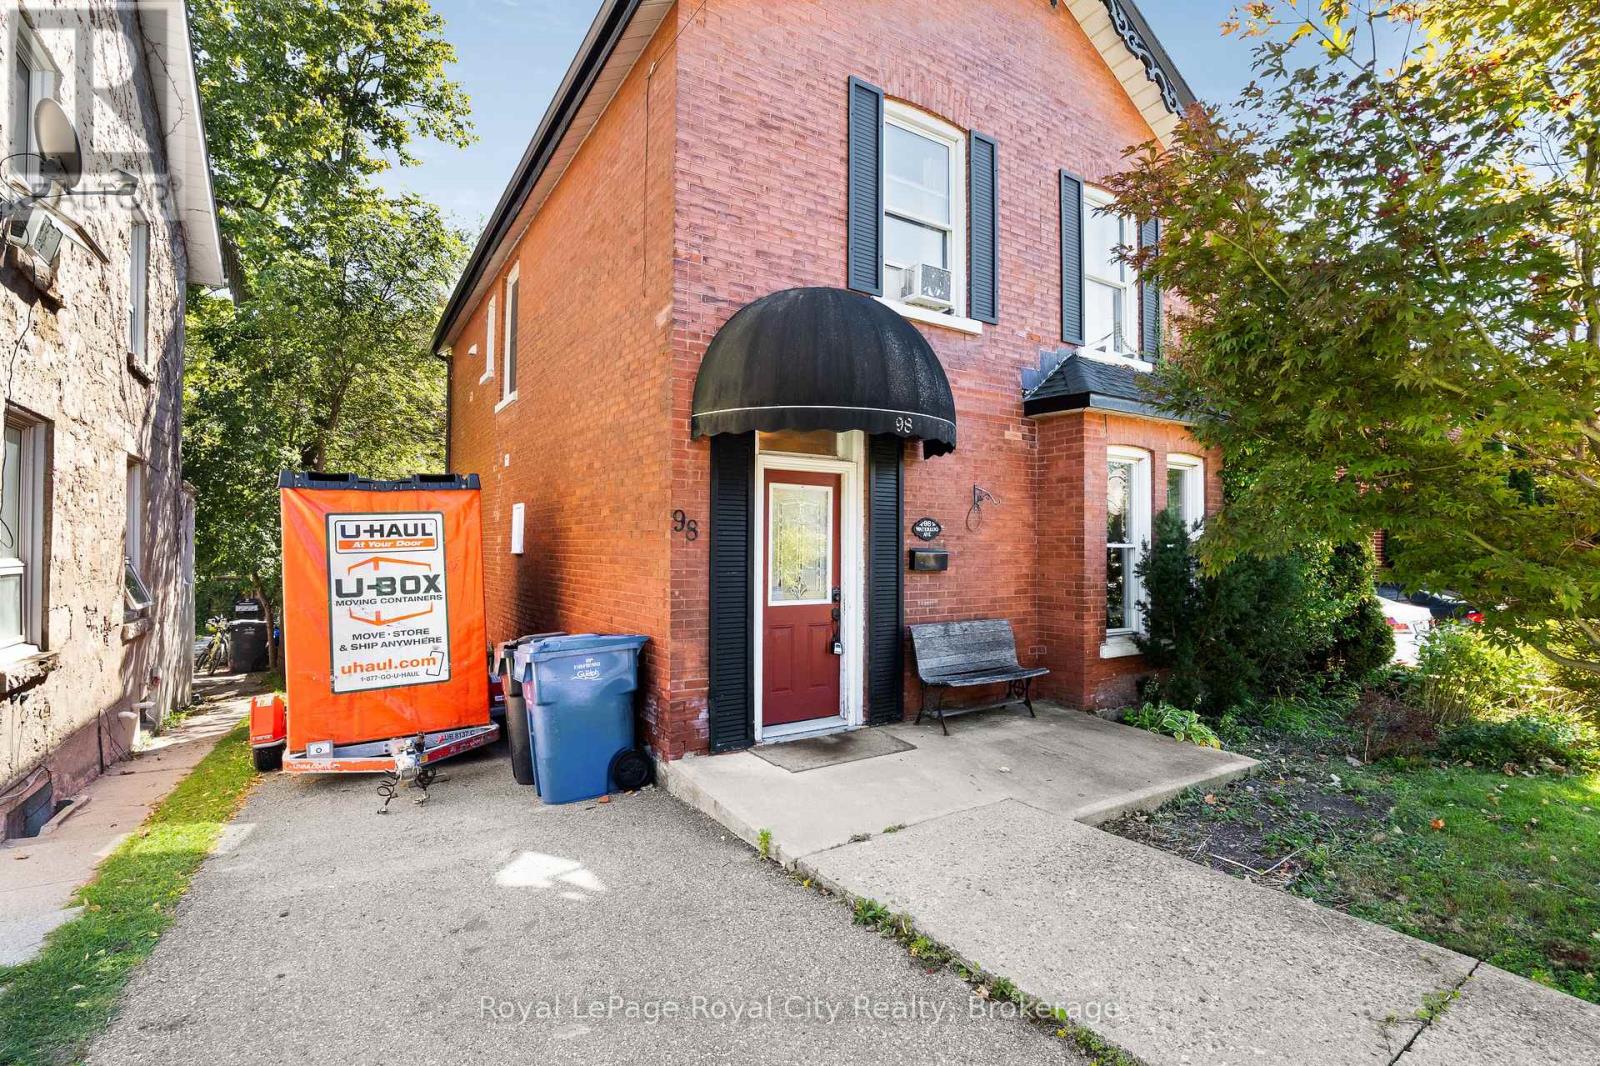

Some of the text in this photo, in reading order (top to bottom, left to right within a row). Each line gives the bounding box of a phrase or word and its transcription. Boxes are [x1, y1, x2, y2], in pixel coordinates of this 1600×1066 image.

[895, 417, 913, 433] 98
[340, 523, 433, 538] U-HAUL
[672, 509, 698, 541] 98
[335, 574, 442, 598] U-BOX
[335, 594, 443, 607] MOVING CONTAINERS
[352, 628, 430, 640] MOVE STORE
[339, 636, 442, 652] & SHIP ANYWHERE
[341, 657, 436, 675] uhaul.com
[360, 671, 420, 682] 1-877-GO-U-HAUL
